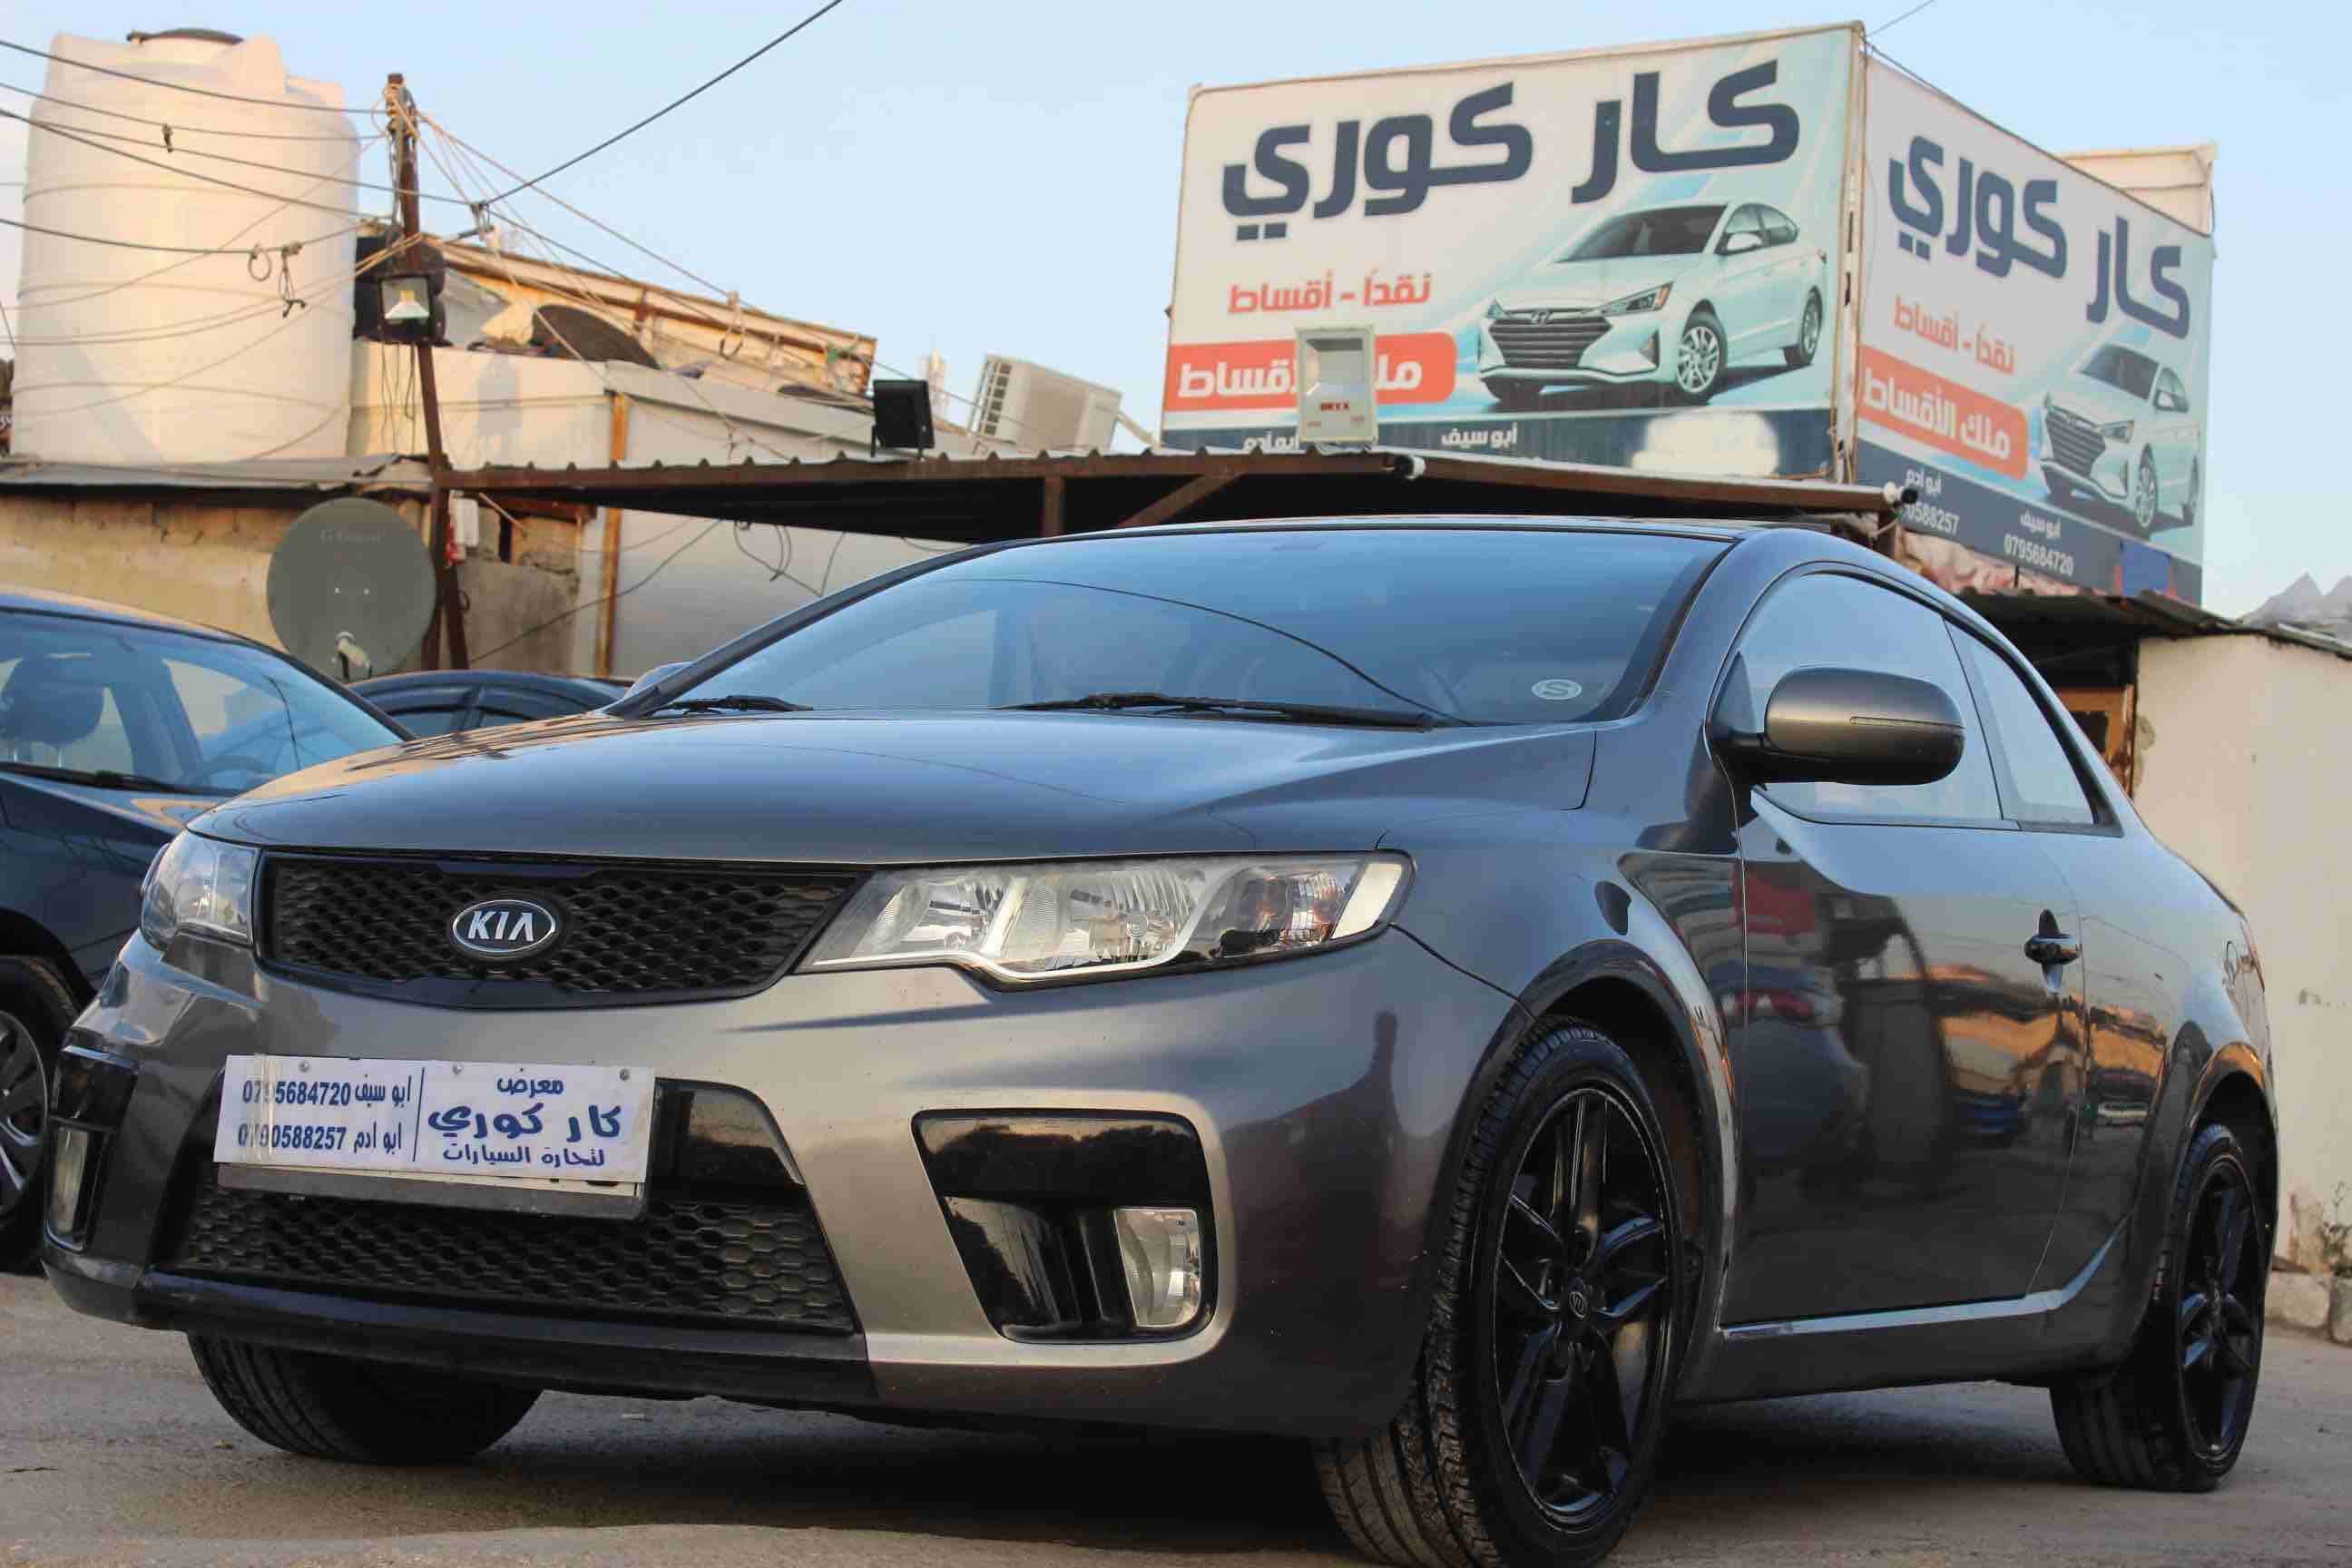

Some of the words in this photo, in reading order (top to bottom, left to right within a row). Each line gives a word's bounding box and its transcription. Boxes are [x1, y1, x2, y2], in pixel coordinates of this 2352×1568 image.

[1570, 59, 1800, 204] كار
[1221, 82, 1534, 241] كوري
[1888, 136, 2067, 279] كوري
[2086, 216, 2190, 339] كار
[1960, 413, 2011, 460] ملك
[467, 910, 534, 942] KIA
[427, 1102, 544, 1140] كوري
[565, 1103, 622, 1143] كار
[443, 1142, 531, 1165] السيارات
